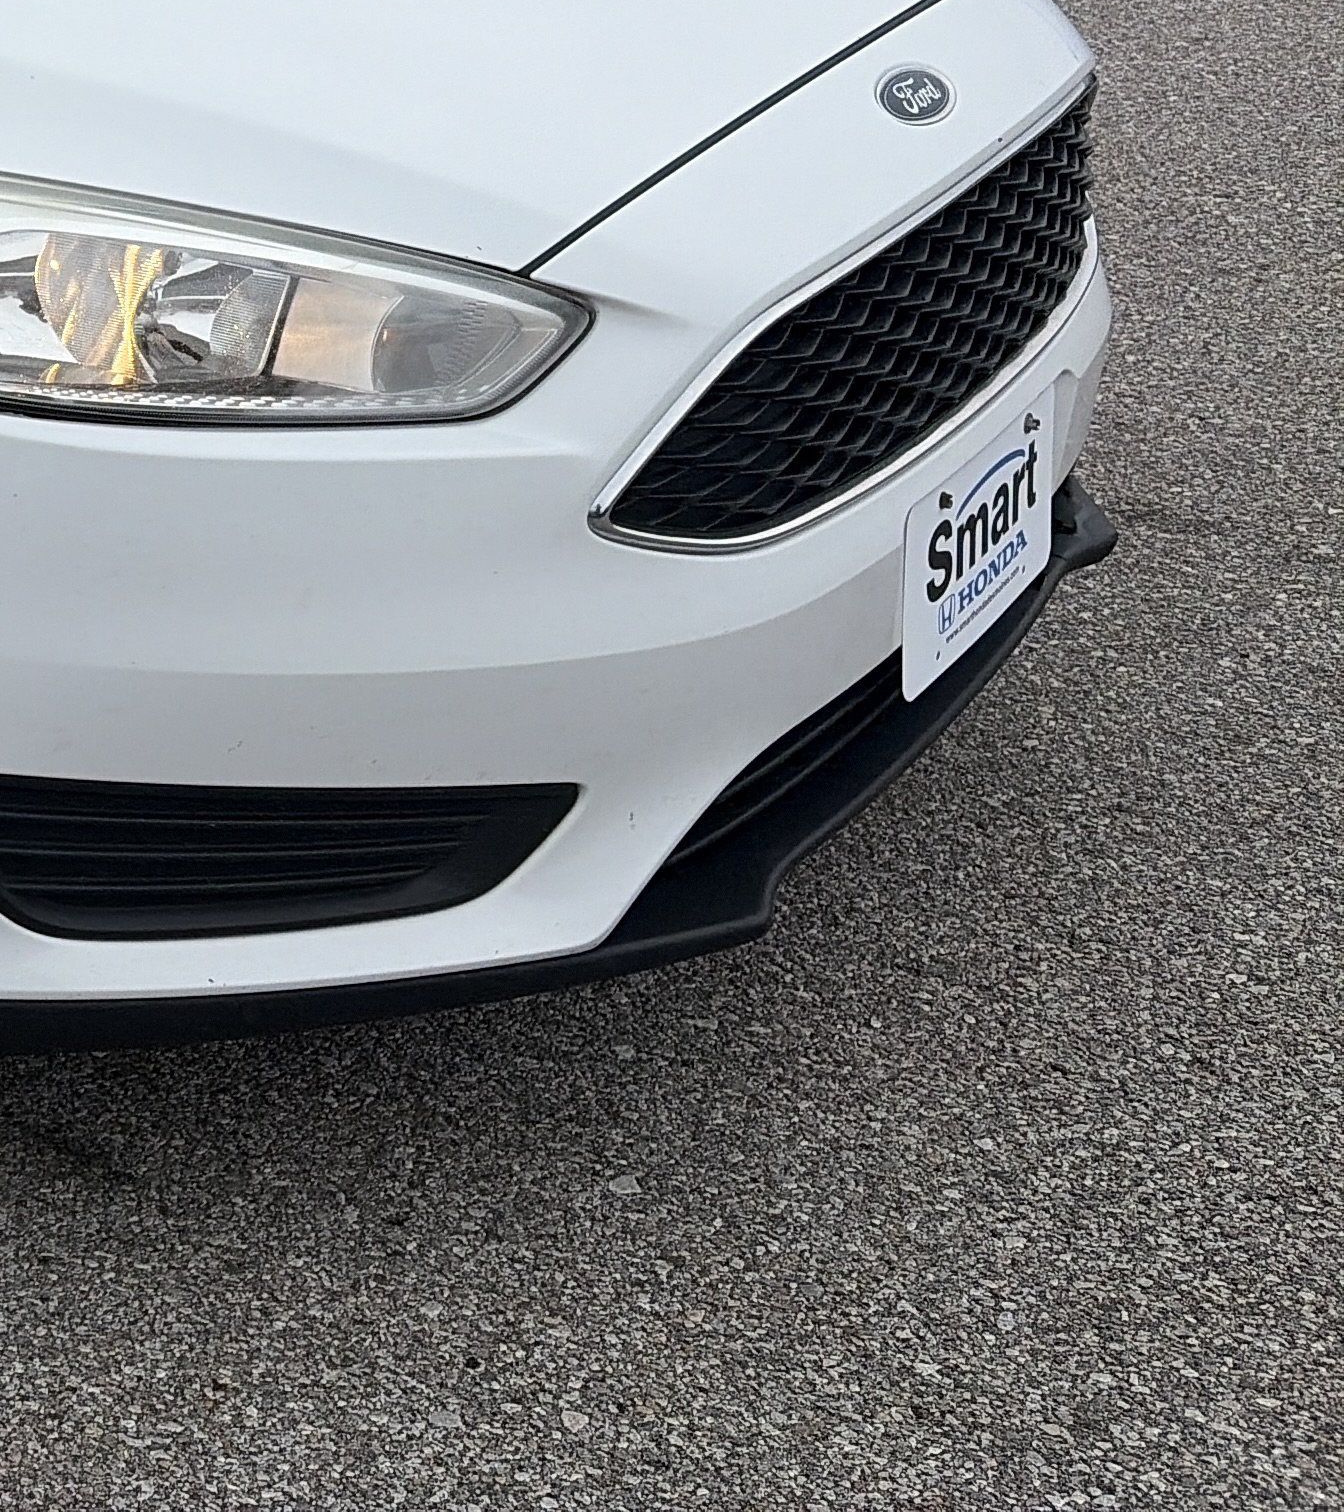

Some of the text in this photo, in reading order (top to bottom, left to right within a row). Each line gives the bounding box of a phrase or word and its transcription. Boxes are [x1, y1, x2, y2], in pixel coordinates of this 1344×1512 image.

[892, 77, 942, 115] Ford
[926, 439, 1038, 603] Smart
[957, 529, 1028, 615] HONDA
